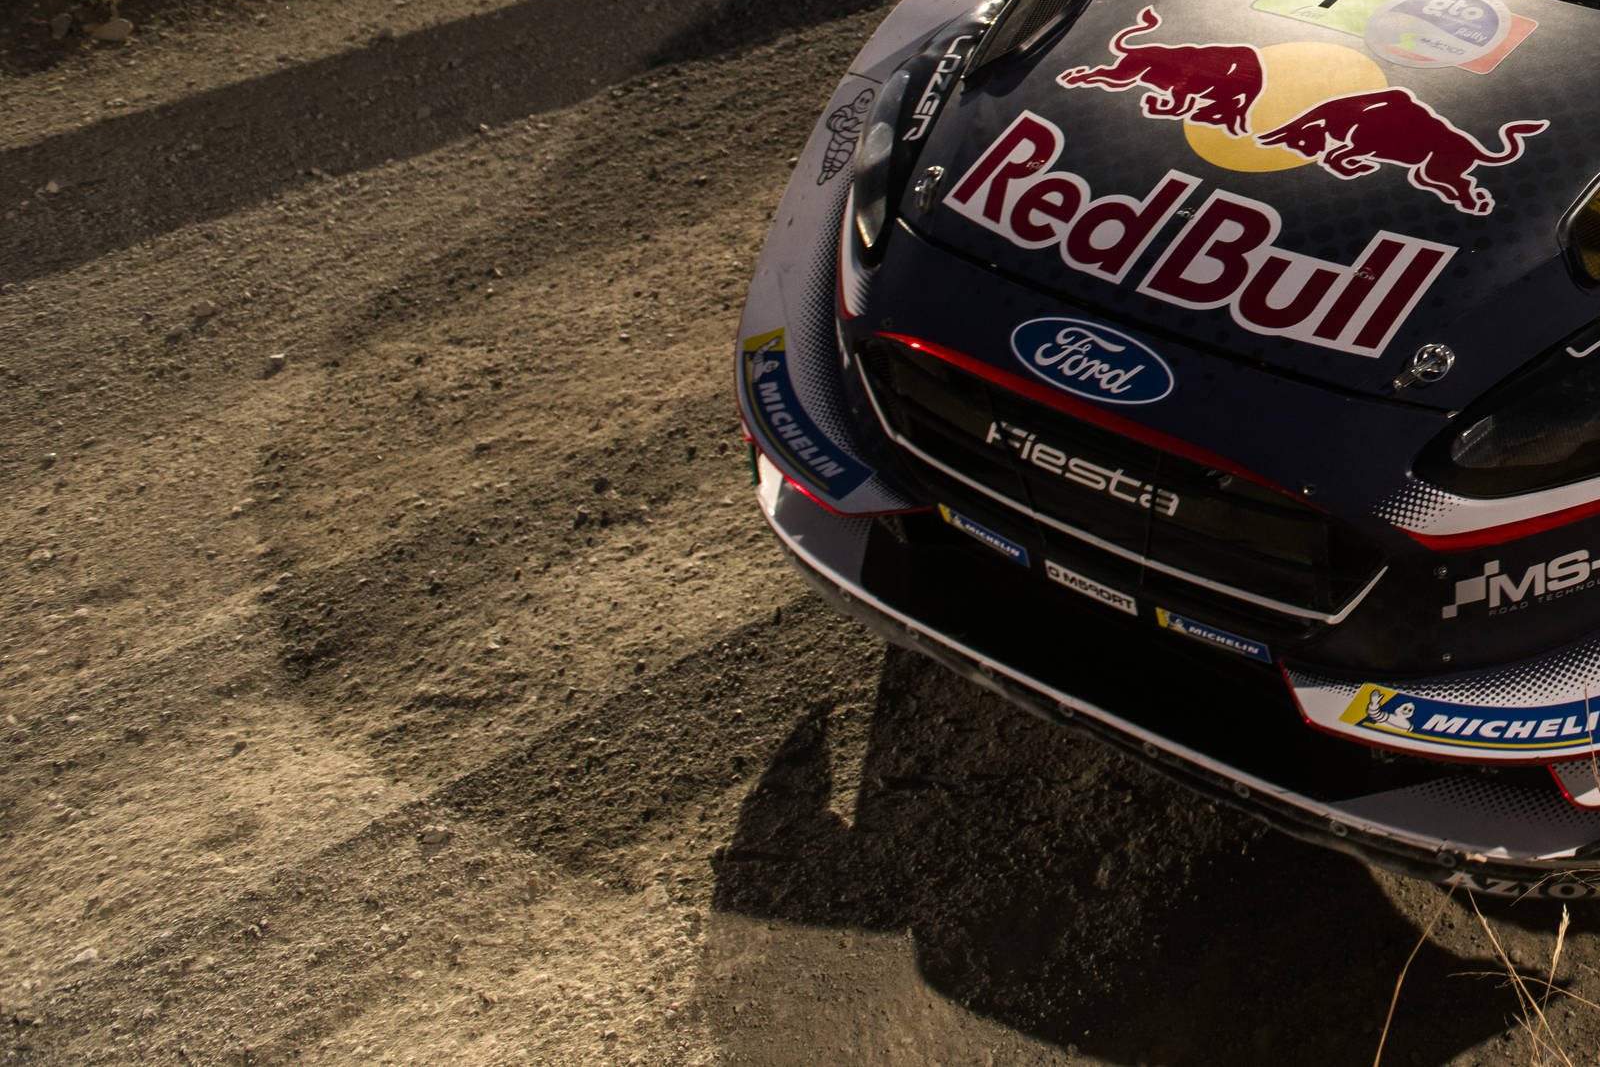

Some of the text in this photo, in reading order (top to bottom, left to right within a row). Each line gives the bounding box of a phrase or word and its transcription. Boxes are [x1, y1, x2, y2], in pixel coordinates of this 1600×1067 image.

[944, 110, 1459, 359] Red Bull
[1034, 326, 1146, 394] Ford
[758, 381, 847, 479] MICHELIN
[985, 420, 1180, 518] Fiesta
[966, 524, 1021, 558] MICHELIN
[1188, 625, 1259, 655] MICHELIN
[1488, 600, 1530, 616] ROAD
